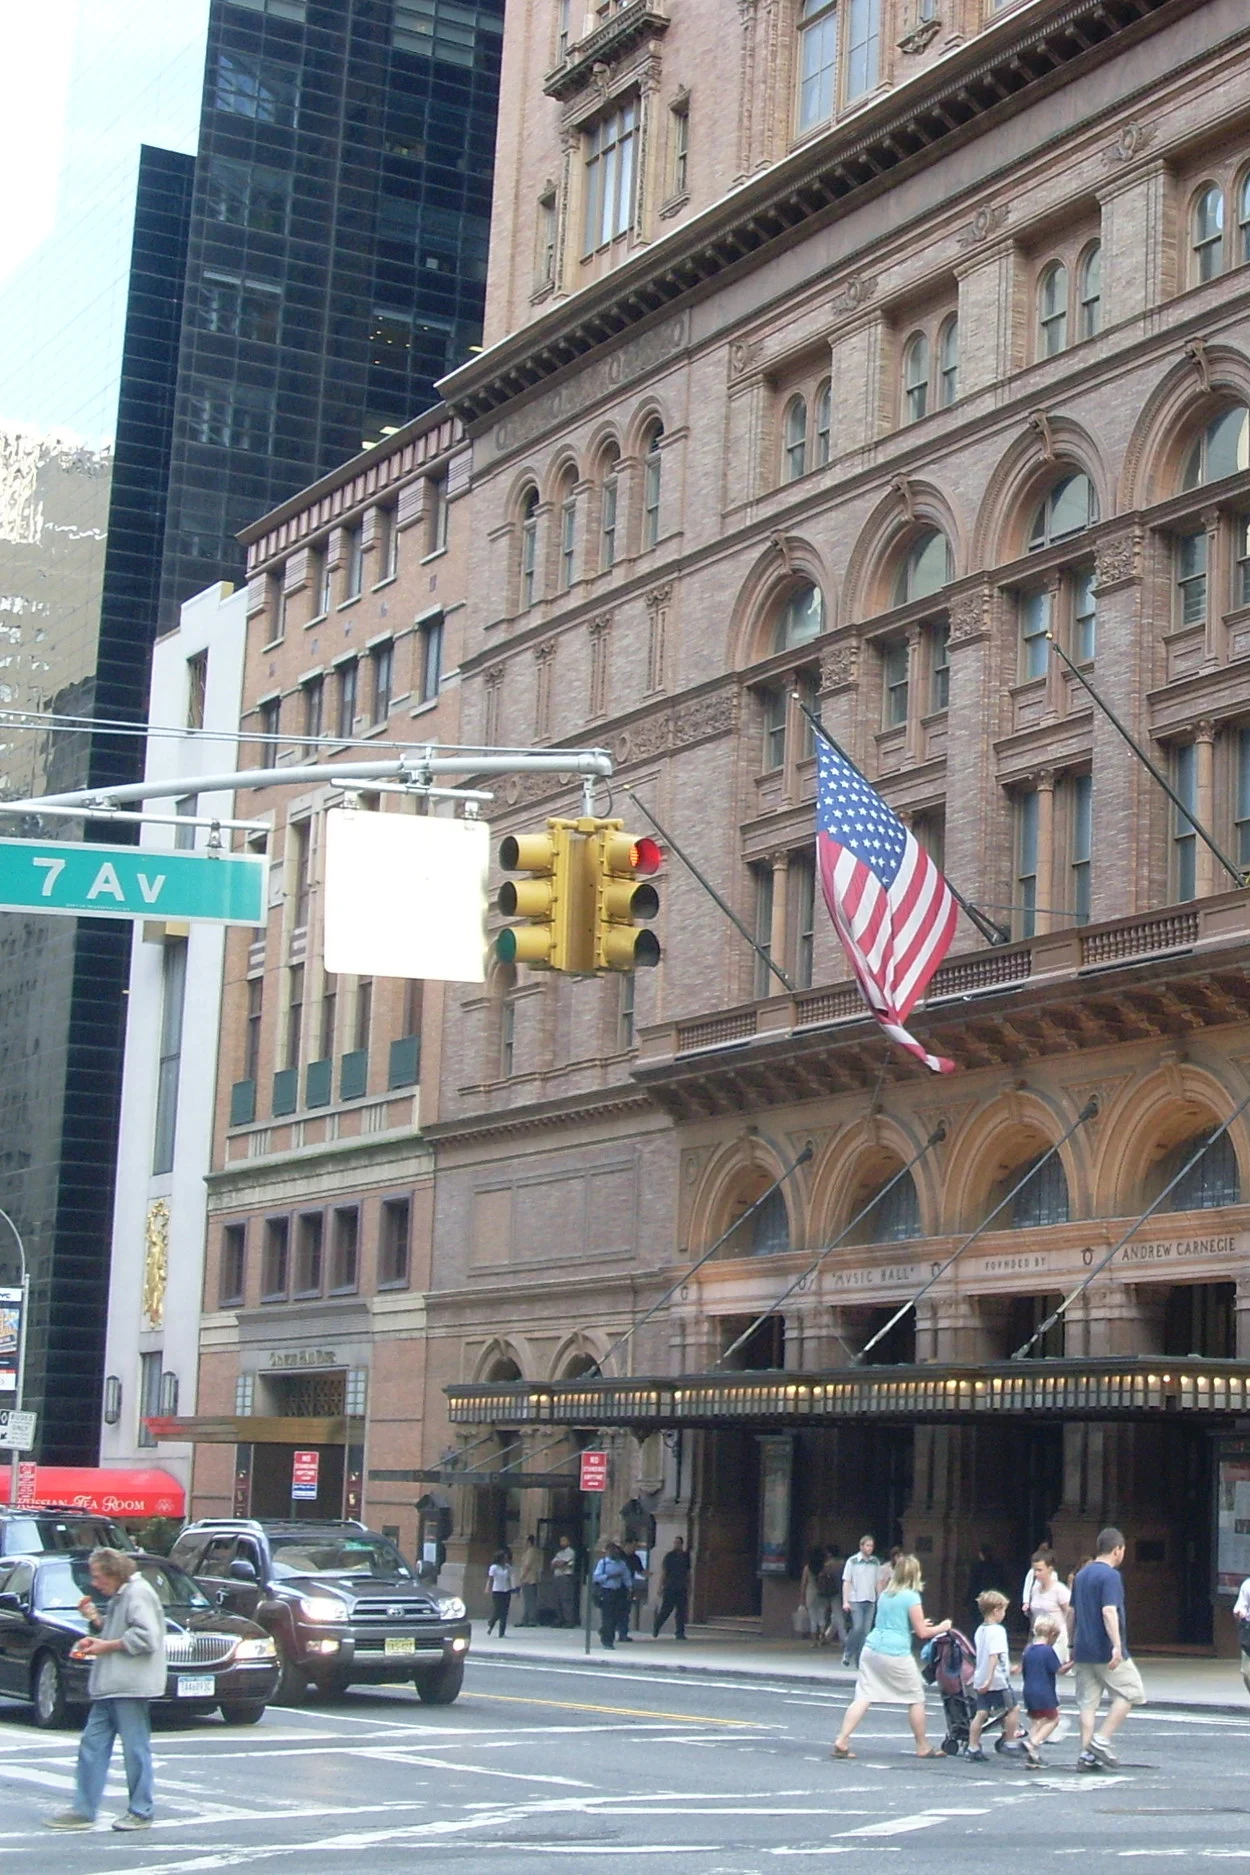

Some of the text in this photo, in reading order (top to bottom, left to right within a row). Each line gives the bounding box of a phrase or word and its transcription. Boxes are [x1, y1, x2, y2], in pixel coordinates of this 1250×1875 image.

[32, 856, 66, 897] 7
[1122, 1237, 1236, 1261] ANDREW CARNEGIE
[102, 1495, 145, 1512] ROOM
